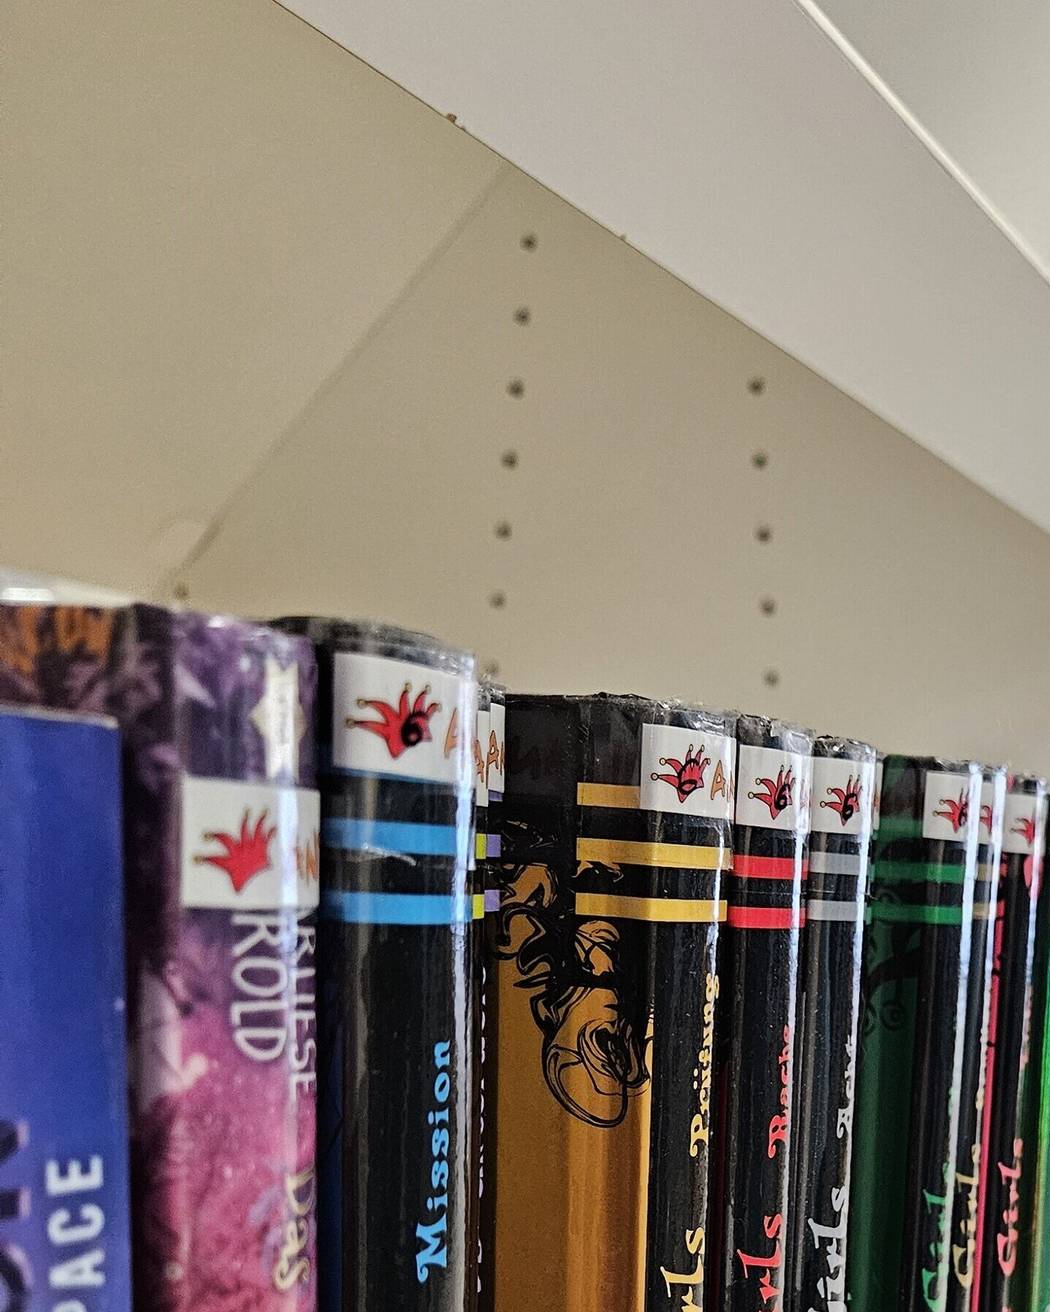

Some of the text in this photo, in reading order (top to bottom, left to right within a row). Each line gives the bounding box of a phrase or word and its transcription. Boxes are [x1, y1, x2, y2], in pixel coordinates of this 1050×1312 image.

[689, 973, 719, 1158] Prüfung
[767, 1024, 792, 1159] Rache
[272, 1169, 318, 1292] Das
[416, 1039, 452, 1283] Mission
